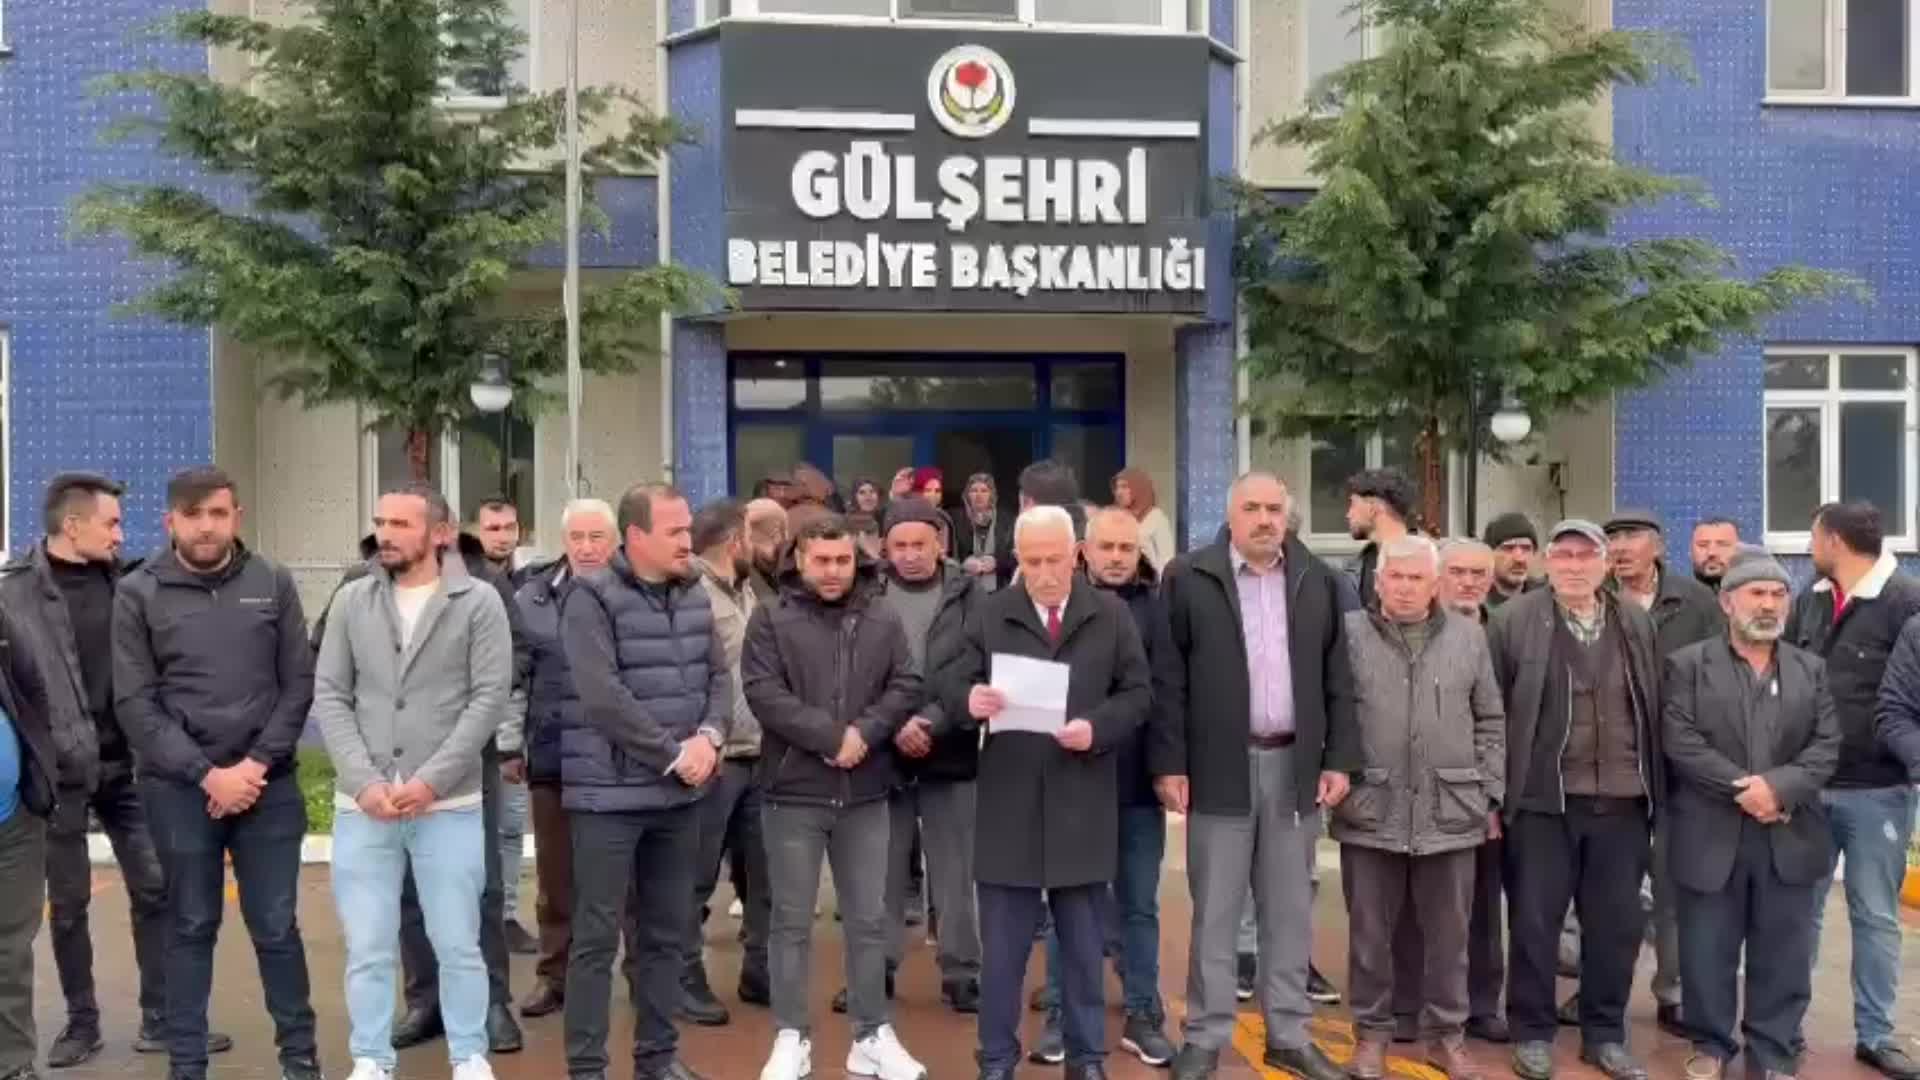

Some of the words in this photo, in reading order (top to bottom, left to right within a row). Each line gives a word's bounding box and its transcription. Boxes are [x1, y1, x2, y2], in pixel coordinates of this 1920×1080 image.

[791, 140, 1147, 231] GÜLŞEHRİ
[727, 232, 937, 288] BELEDİYE
[950, 236, 1206, 297] BAŞKANLIĞI
